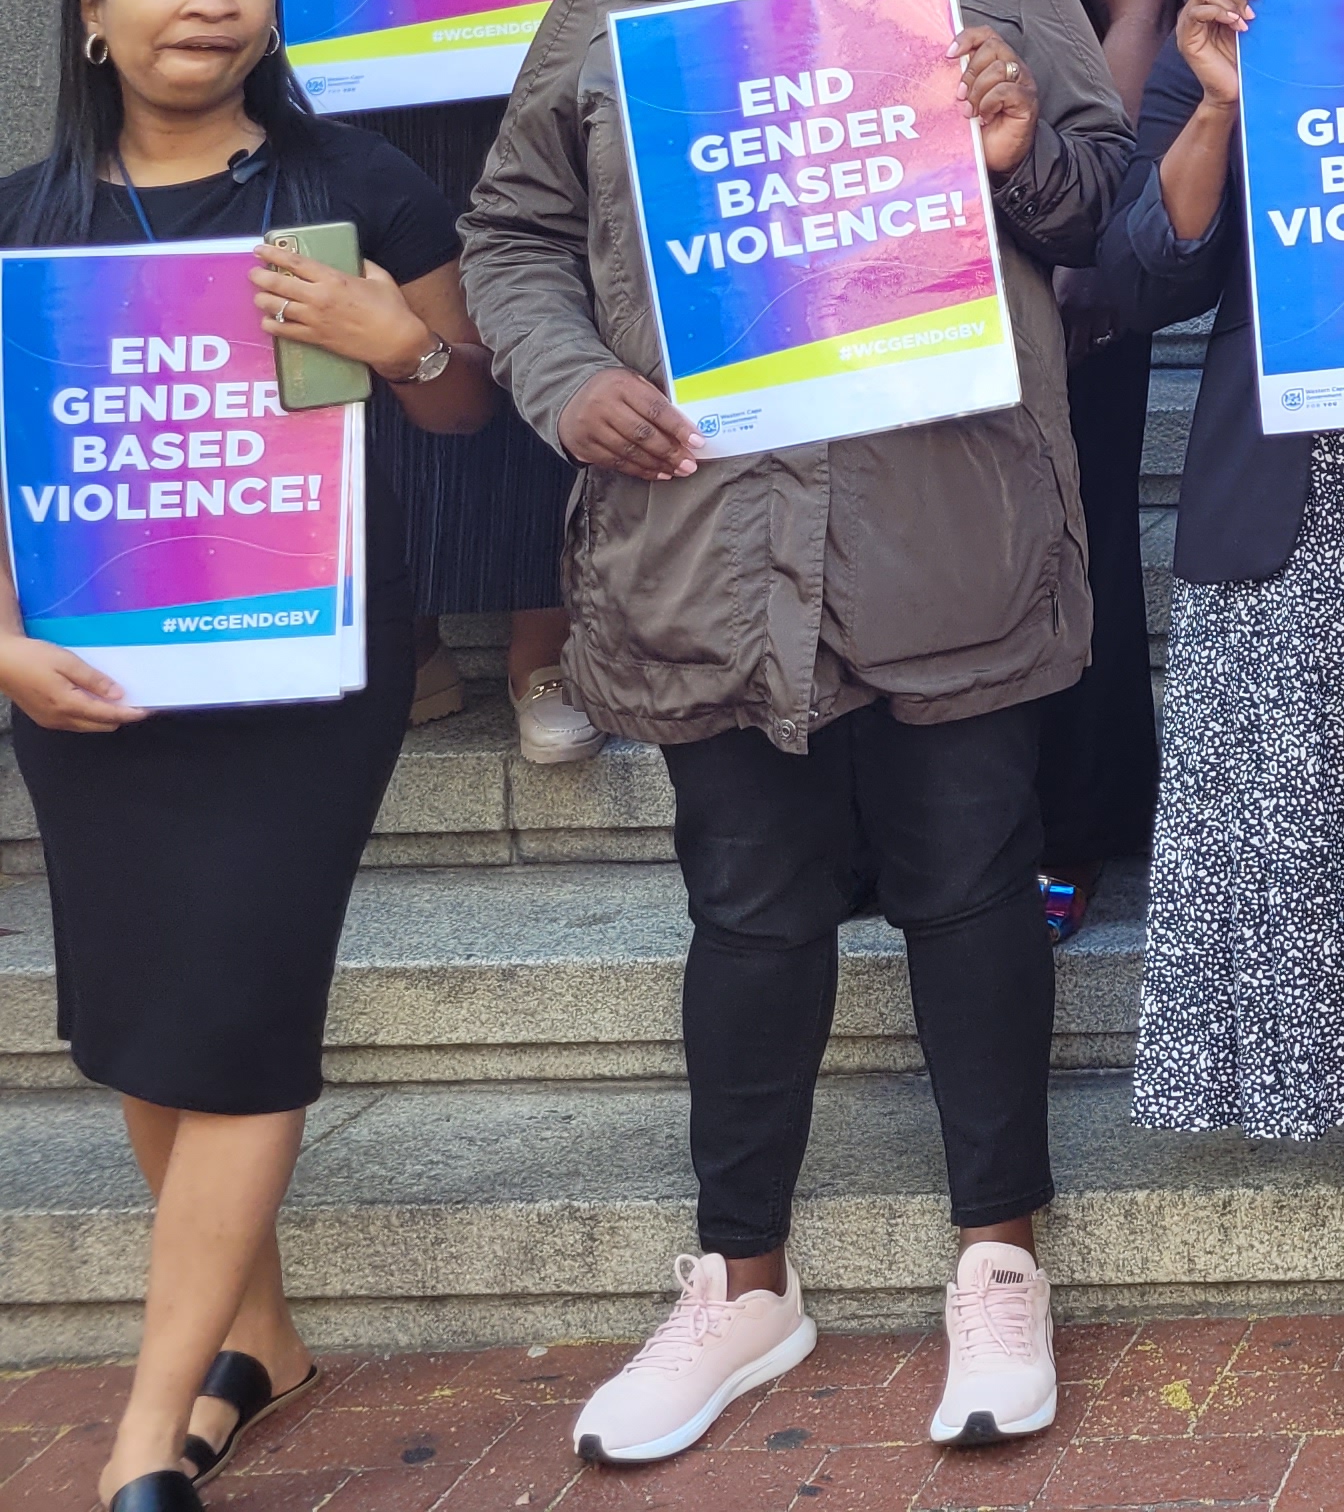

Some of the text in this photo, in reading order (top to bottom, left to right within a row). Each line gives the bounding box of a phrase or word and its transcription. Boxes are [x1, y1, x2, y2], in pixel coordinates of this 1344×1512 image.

[738, 66, 855, 118] END
[689, 103, 919, 173] GENDER
[716, 155, 904, 219] BASED
[666, 190, 967, 276] VIOLENCE!
[110, 336, 231, 375] END
[838, 321, 986, 362] #WCGENDGBV
[53, 384, 288, 423] GENDER
[72, 430, 265, 473] BASED
[21, 475, 323, 523] VIOLENCE!
[162, 609, 320, 633] #WCGENDGBV
